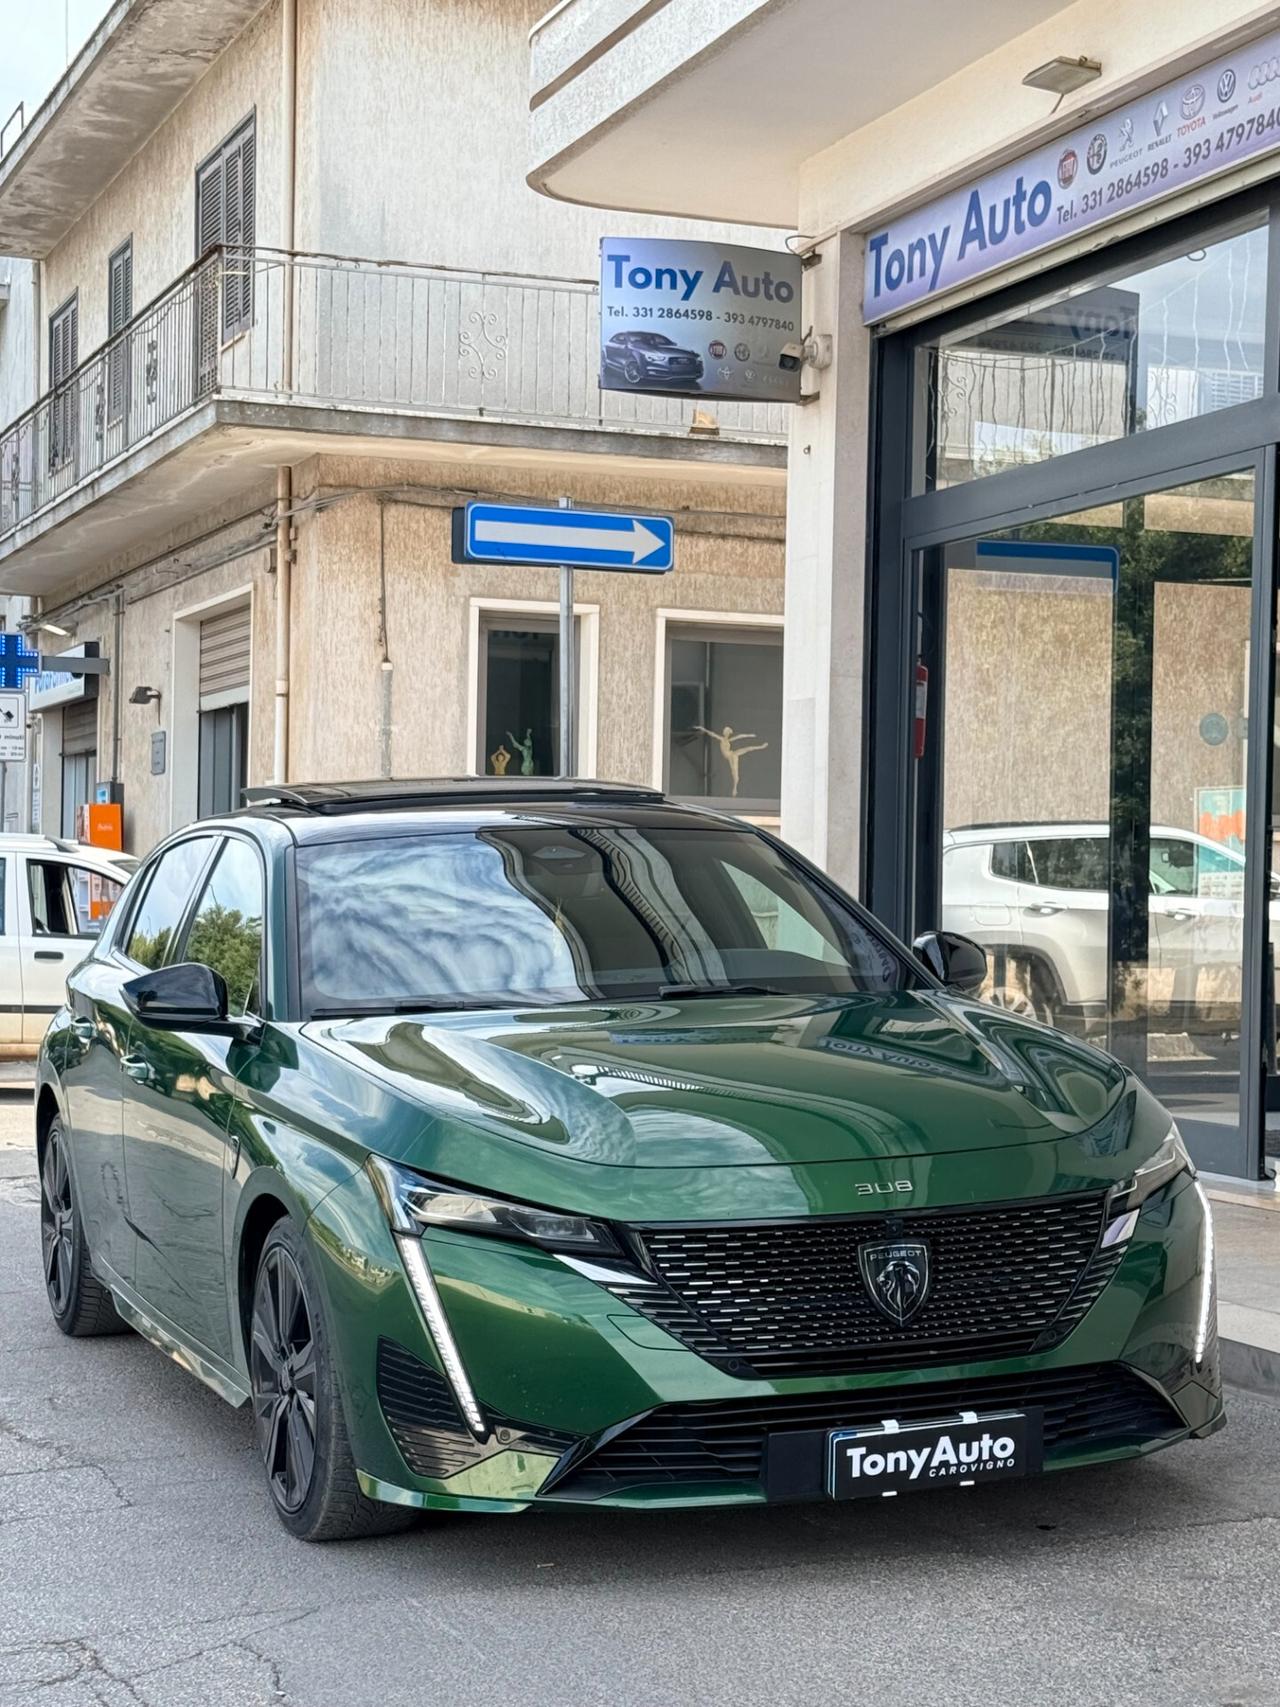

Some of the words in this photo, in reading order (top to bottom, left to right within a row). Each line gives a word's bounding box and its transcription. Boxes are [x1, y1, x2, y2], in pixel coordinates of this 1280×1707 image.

[1176, 116, 1206, 138] TOYOTA
[1109, 148, 1143, 169] PEUGEOT
[1057, 200, 1078, 225] Tel.
[1081, 190, 1103, 214] 331
[1107, 163, 1169, 203] 2864598
[1183, 144, 1211, 169] 393
[869, 225, 950, 298] Tony
[957, 177, 1052, 262] Auto
[607, 255, 704, 301] Tony
[712, 260, 795, 303] Auto
[608, 306, 628, 317] Tel.
[633, 307, 653, 318] 331
[658, 309, 713, 321] 2864598
[724, 312, 745, 324] 393
[749, 316, 794, 331] 4797840
[870, 1250, 922, 1260] PEUGEOT
[846, 1433, 1015, 1479] TonyAuto
[929, 1458, 1015, 1477] CAROVIGNO
